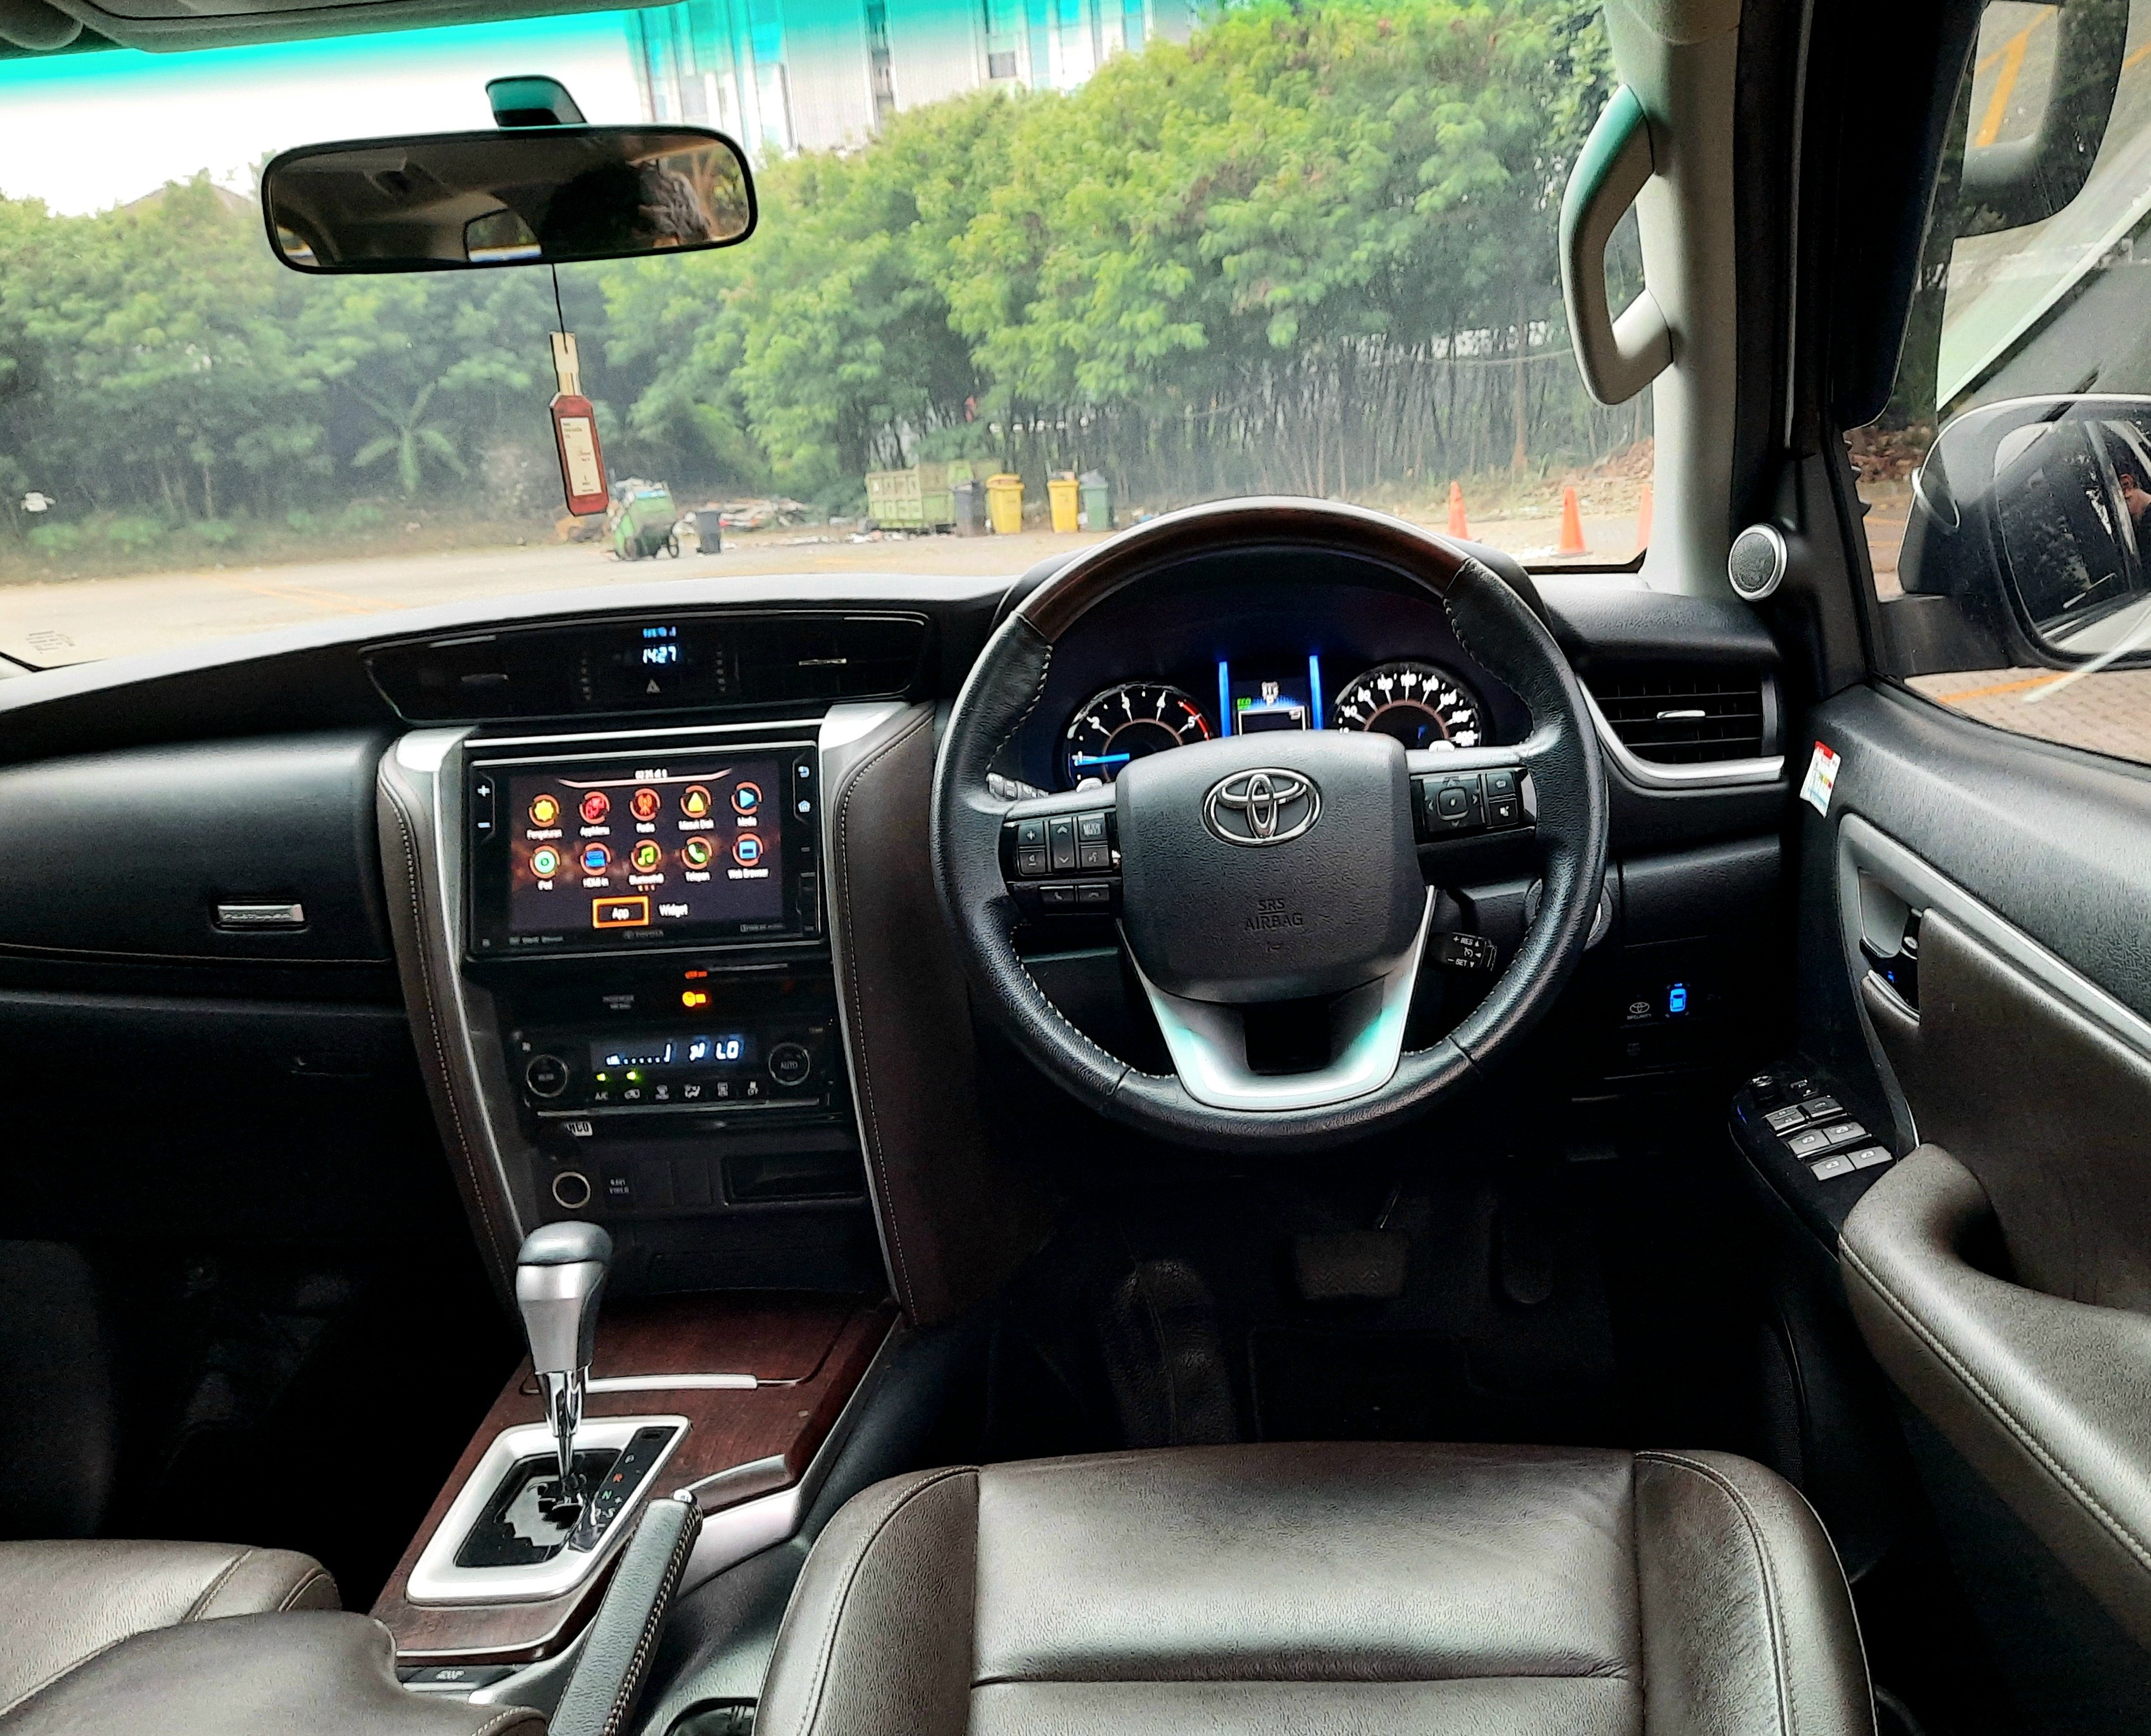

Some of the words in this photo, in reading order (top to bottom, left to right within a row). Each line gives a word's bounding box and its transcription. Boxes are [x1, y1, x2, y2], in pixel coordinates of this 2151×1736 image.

[1343, 704, 1358, 718] 60
[1091, 716, 1101, 729] 2
[1187, 716, 1196, 729] 5
[659, 903, 688, 918] Widget
[1258, 898, 1285, 911] SRS
[612, 907, 630, 920] App
[1244, 913, 1303, 930] AIRBAG
[1455, 958, 1468, 966] SET
[716, 1041, 740, 1060] LO
[779, 1061, 799, 1070] AUTO
[601, 1490, 612, 1500] N
